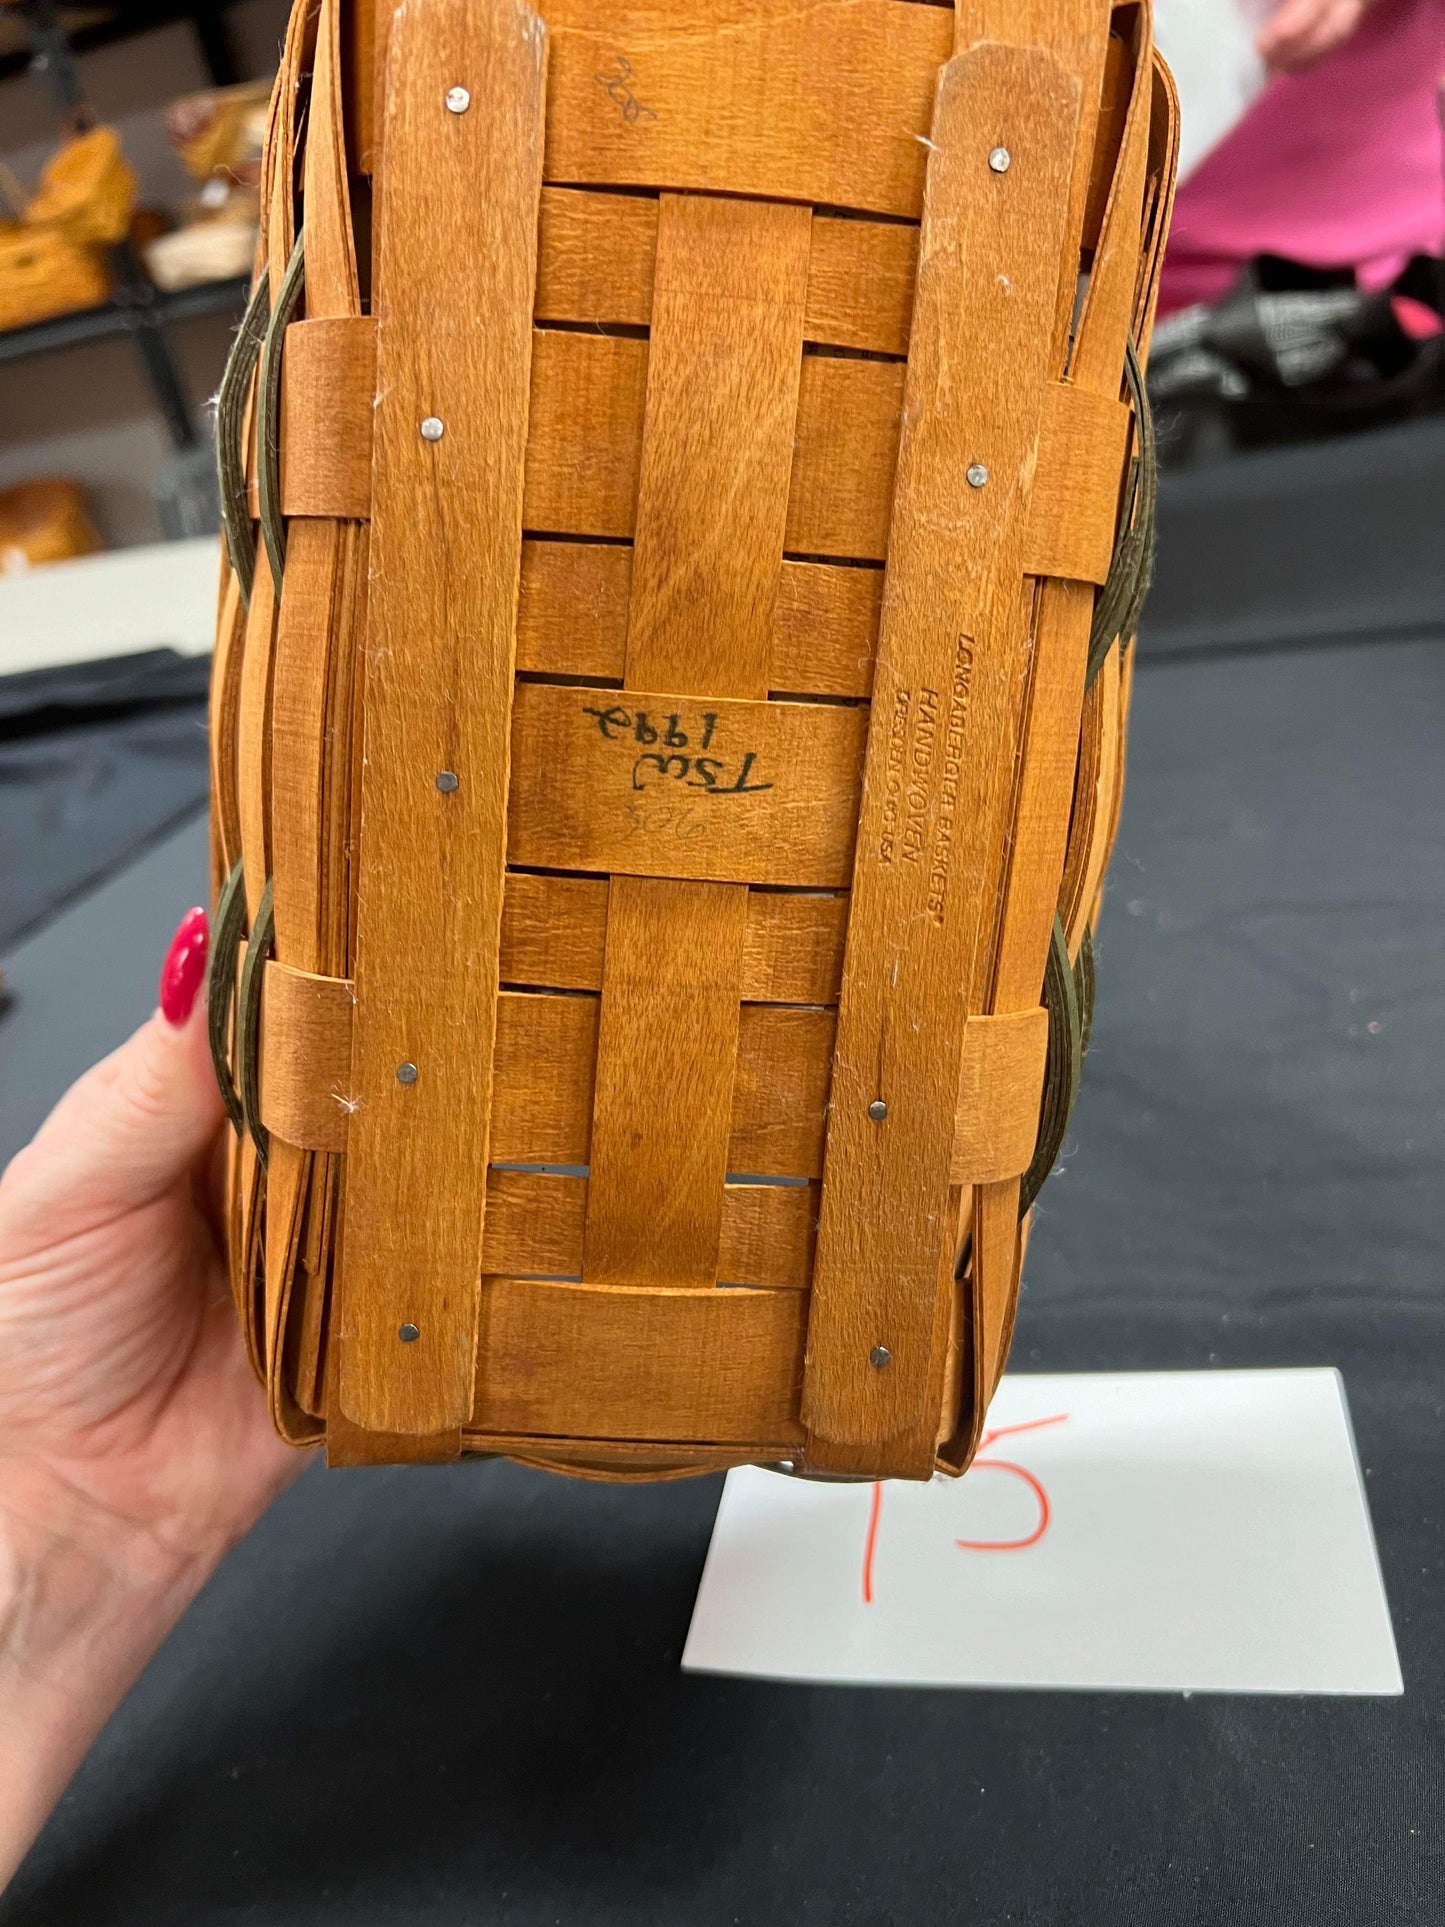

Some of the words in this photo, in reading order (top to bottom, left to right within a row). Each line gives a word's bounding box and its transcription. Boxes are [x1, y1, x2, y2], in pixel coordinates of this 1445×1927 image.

[581, 706, 717, 750] 1992
[901, 687, 938, 865] HANDWOVEN
[940, 632, 975, 810] LONGABERGER
[876, 830, 894, 866] USA
